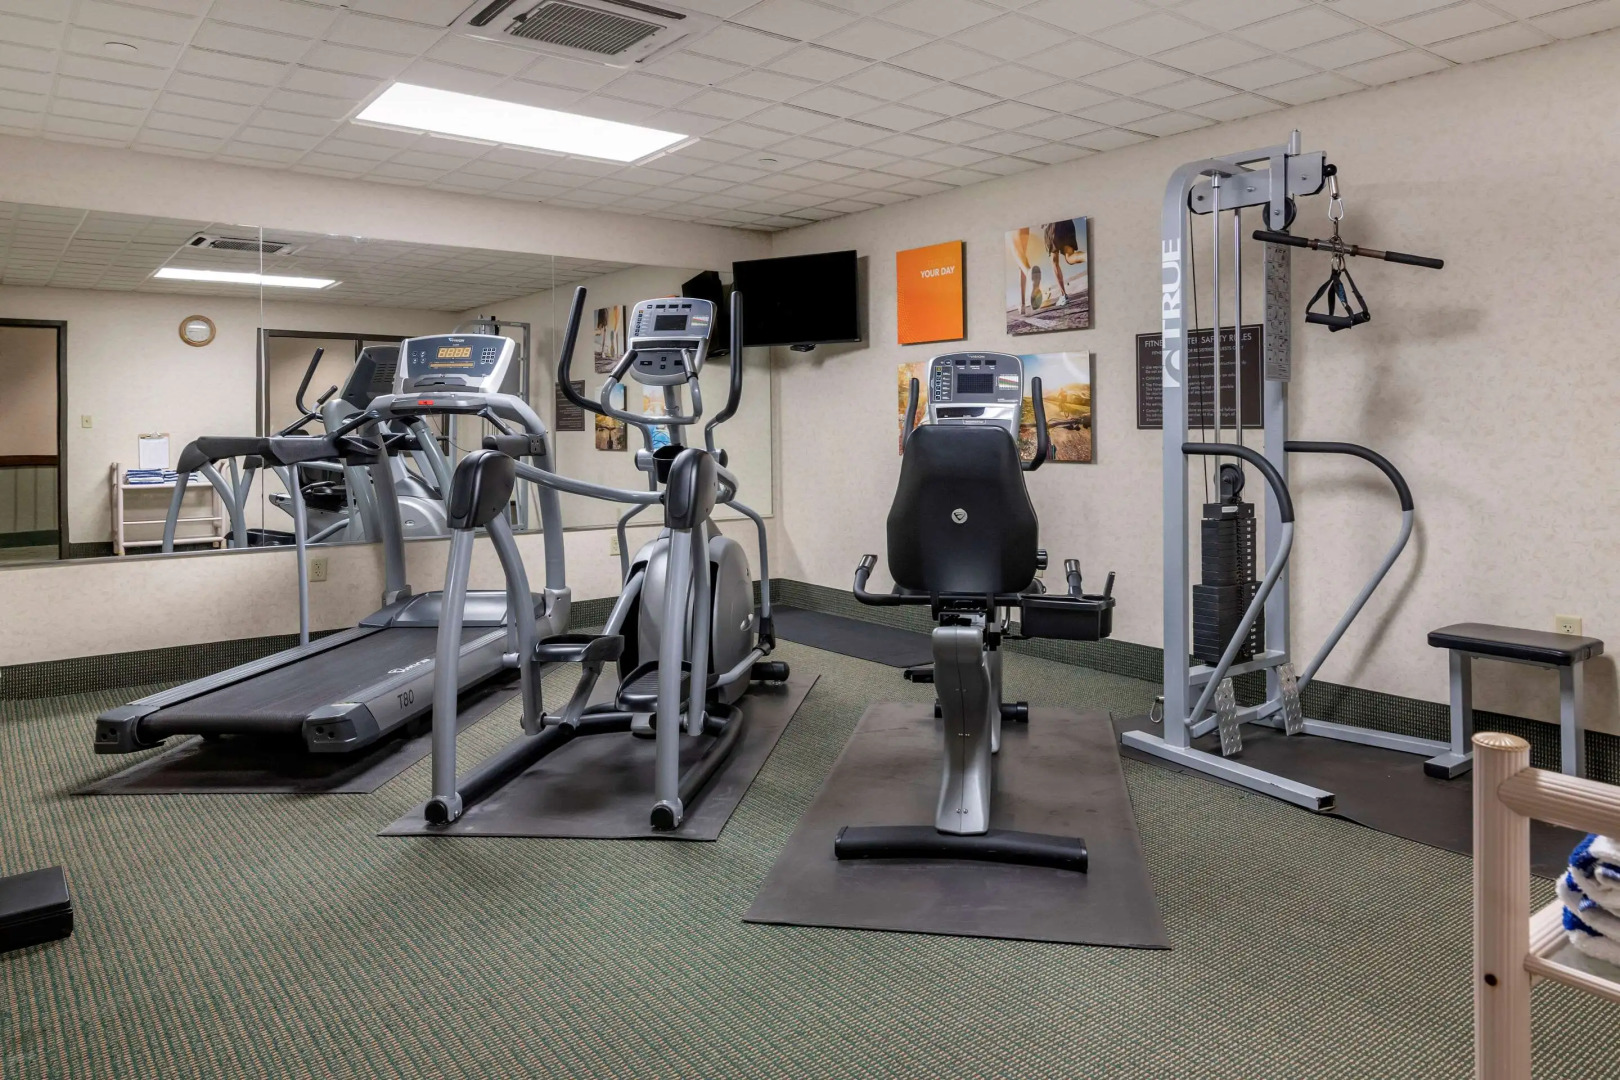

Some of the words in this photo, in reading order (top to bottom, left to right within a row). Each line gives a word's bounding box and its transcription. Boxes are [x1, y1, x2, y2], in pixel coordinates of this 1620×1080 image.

[920, 268, 940, 278] YOUR
[941, 265, 955, 275] DAY
[1162, 238, 1181, 348] TRUE
[1201, 335, 1228, 344] SAFTY
[1229, 332, 1252, 342] RES
[397, 689, 414, 709] T80
